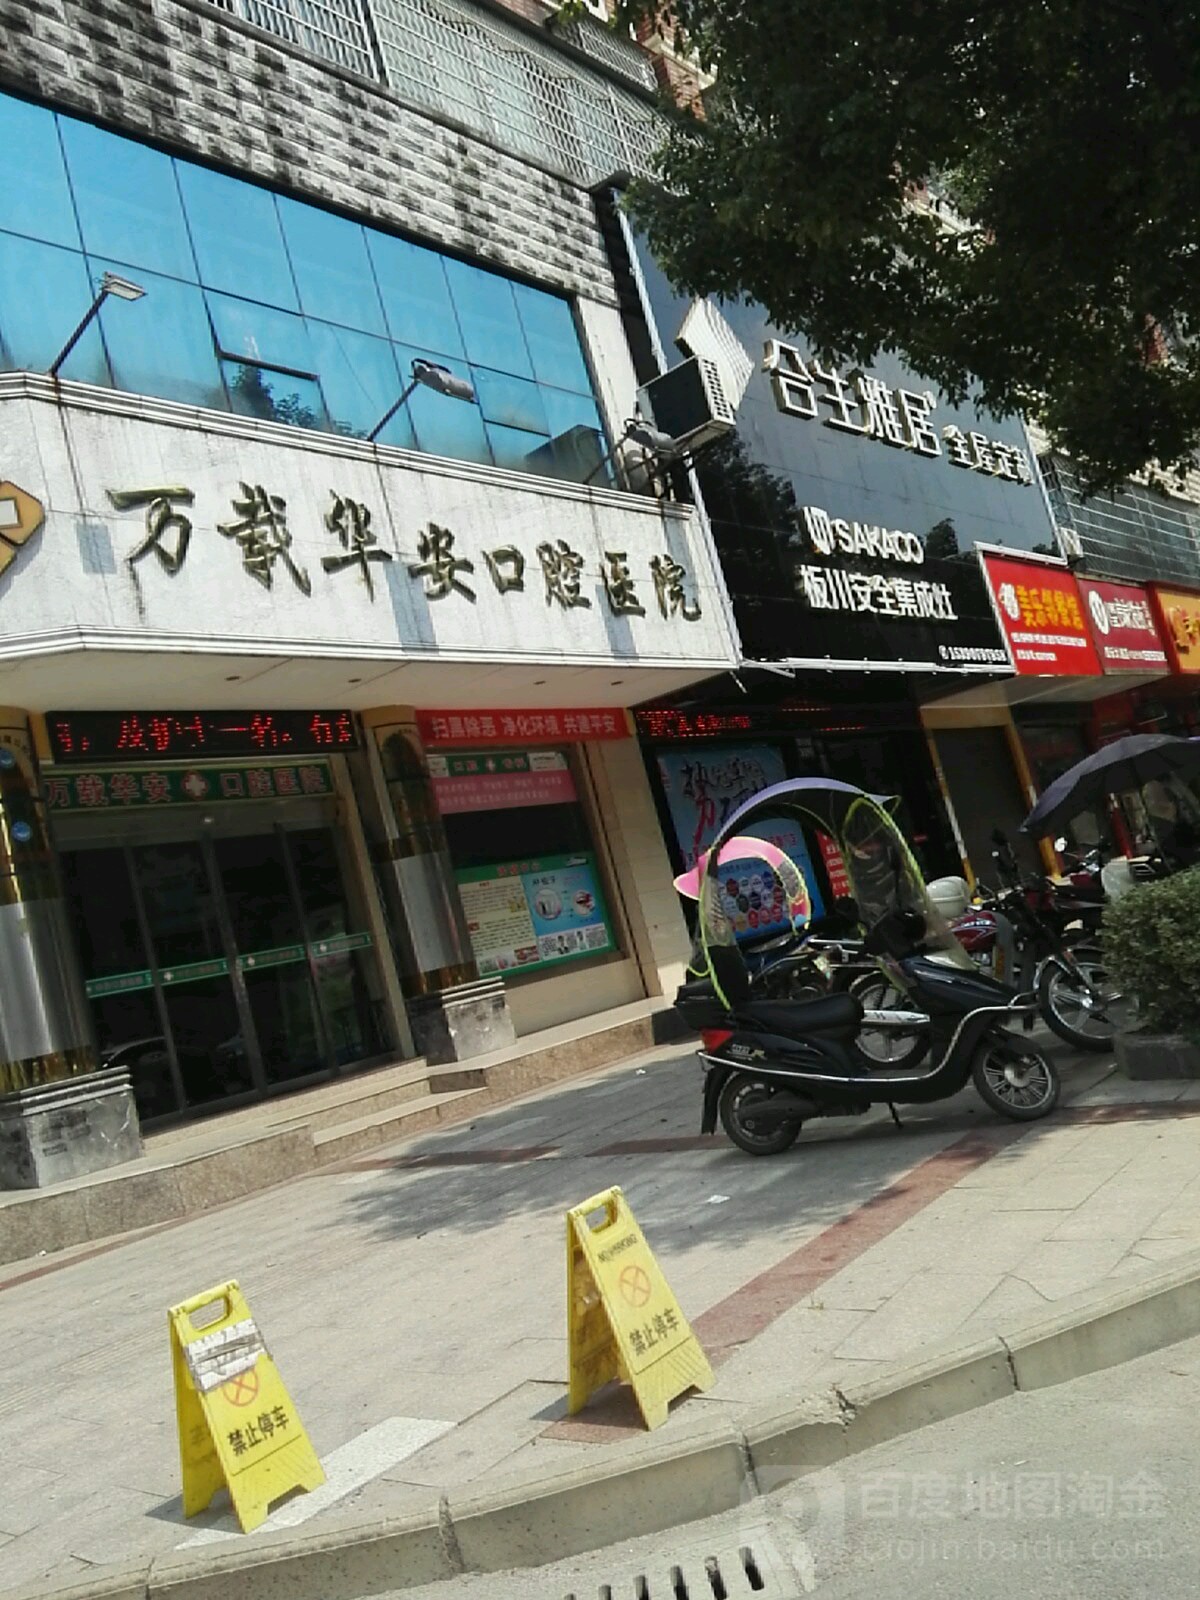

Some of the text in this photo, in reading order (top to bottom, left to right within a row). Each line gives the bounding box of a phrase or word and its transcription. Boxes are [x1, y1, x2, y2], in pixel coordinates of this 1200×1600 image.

[105, 480, 702, 622] 万载华安口腔医院
[799, 564, 958, 621] 板川安全集成灶
[432, 715, 497, 738] 扫黑除恶
[500, 715, 561, 737] 净化环境
[564, 713, 616, 734] 共建平安
[43, 766, 326, 808] 万载华安 口腔医院
[628, 1308, 680, 1357] 禁止停车
[227, 1405, 290, 1457] 禁止停车
